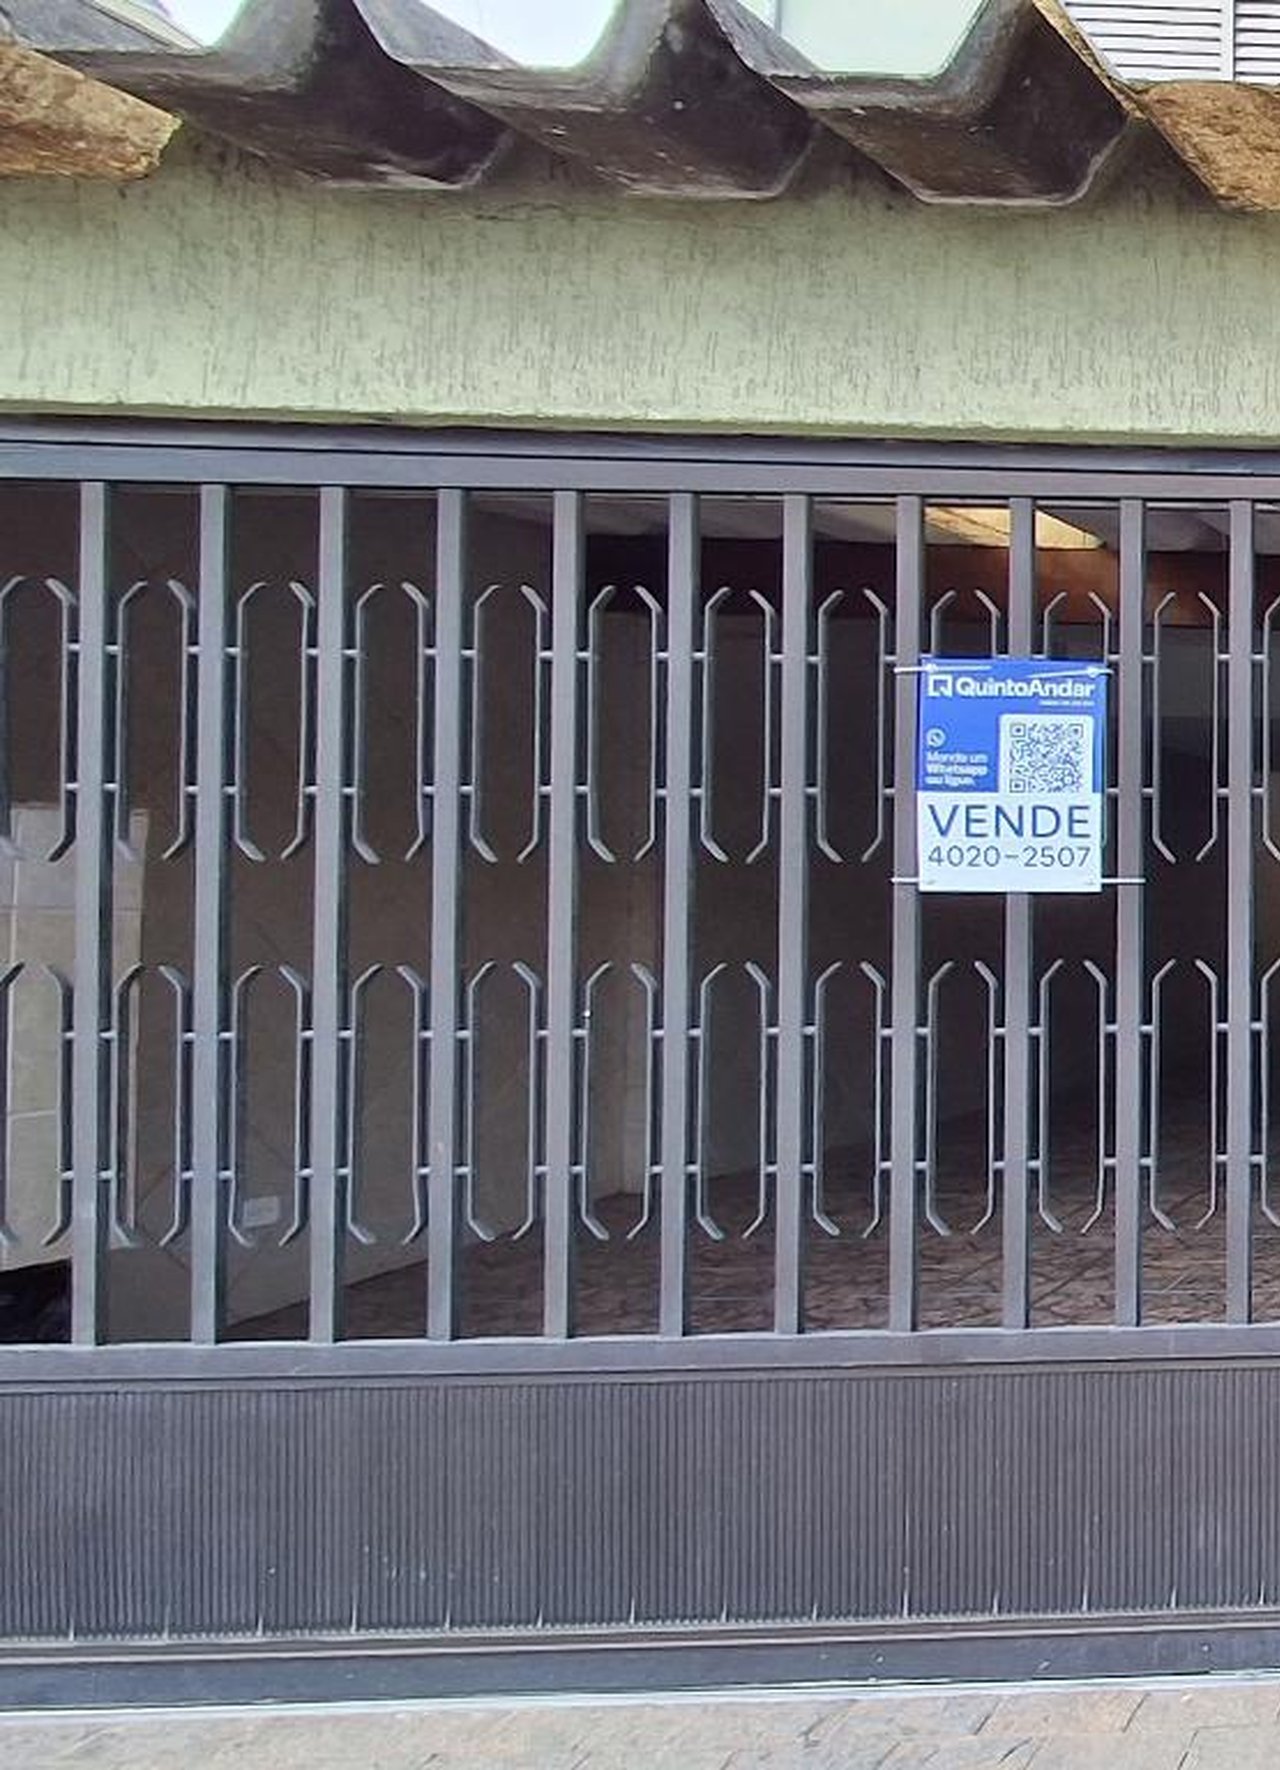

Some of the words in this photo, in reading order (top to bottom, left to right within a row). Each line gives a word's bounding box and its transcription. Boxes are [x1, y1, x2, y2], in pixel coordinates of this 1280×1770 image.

[956, 676, 1095, 698] QuintoAndar
[928, 804, 1091, 838] VENDE
[928, 845, 1092, 868] 4020-2507
